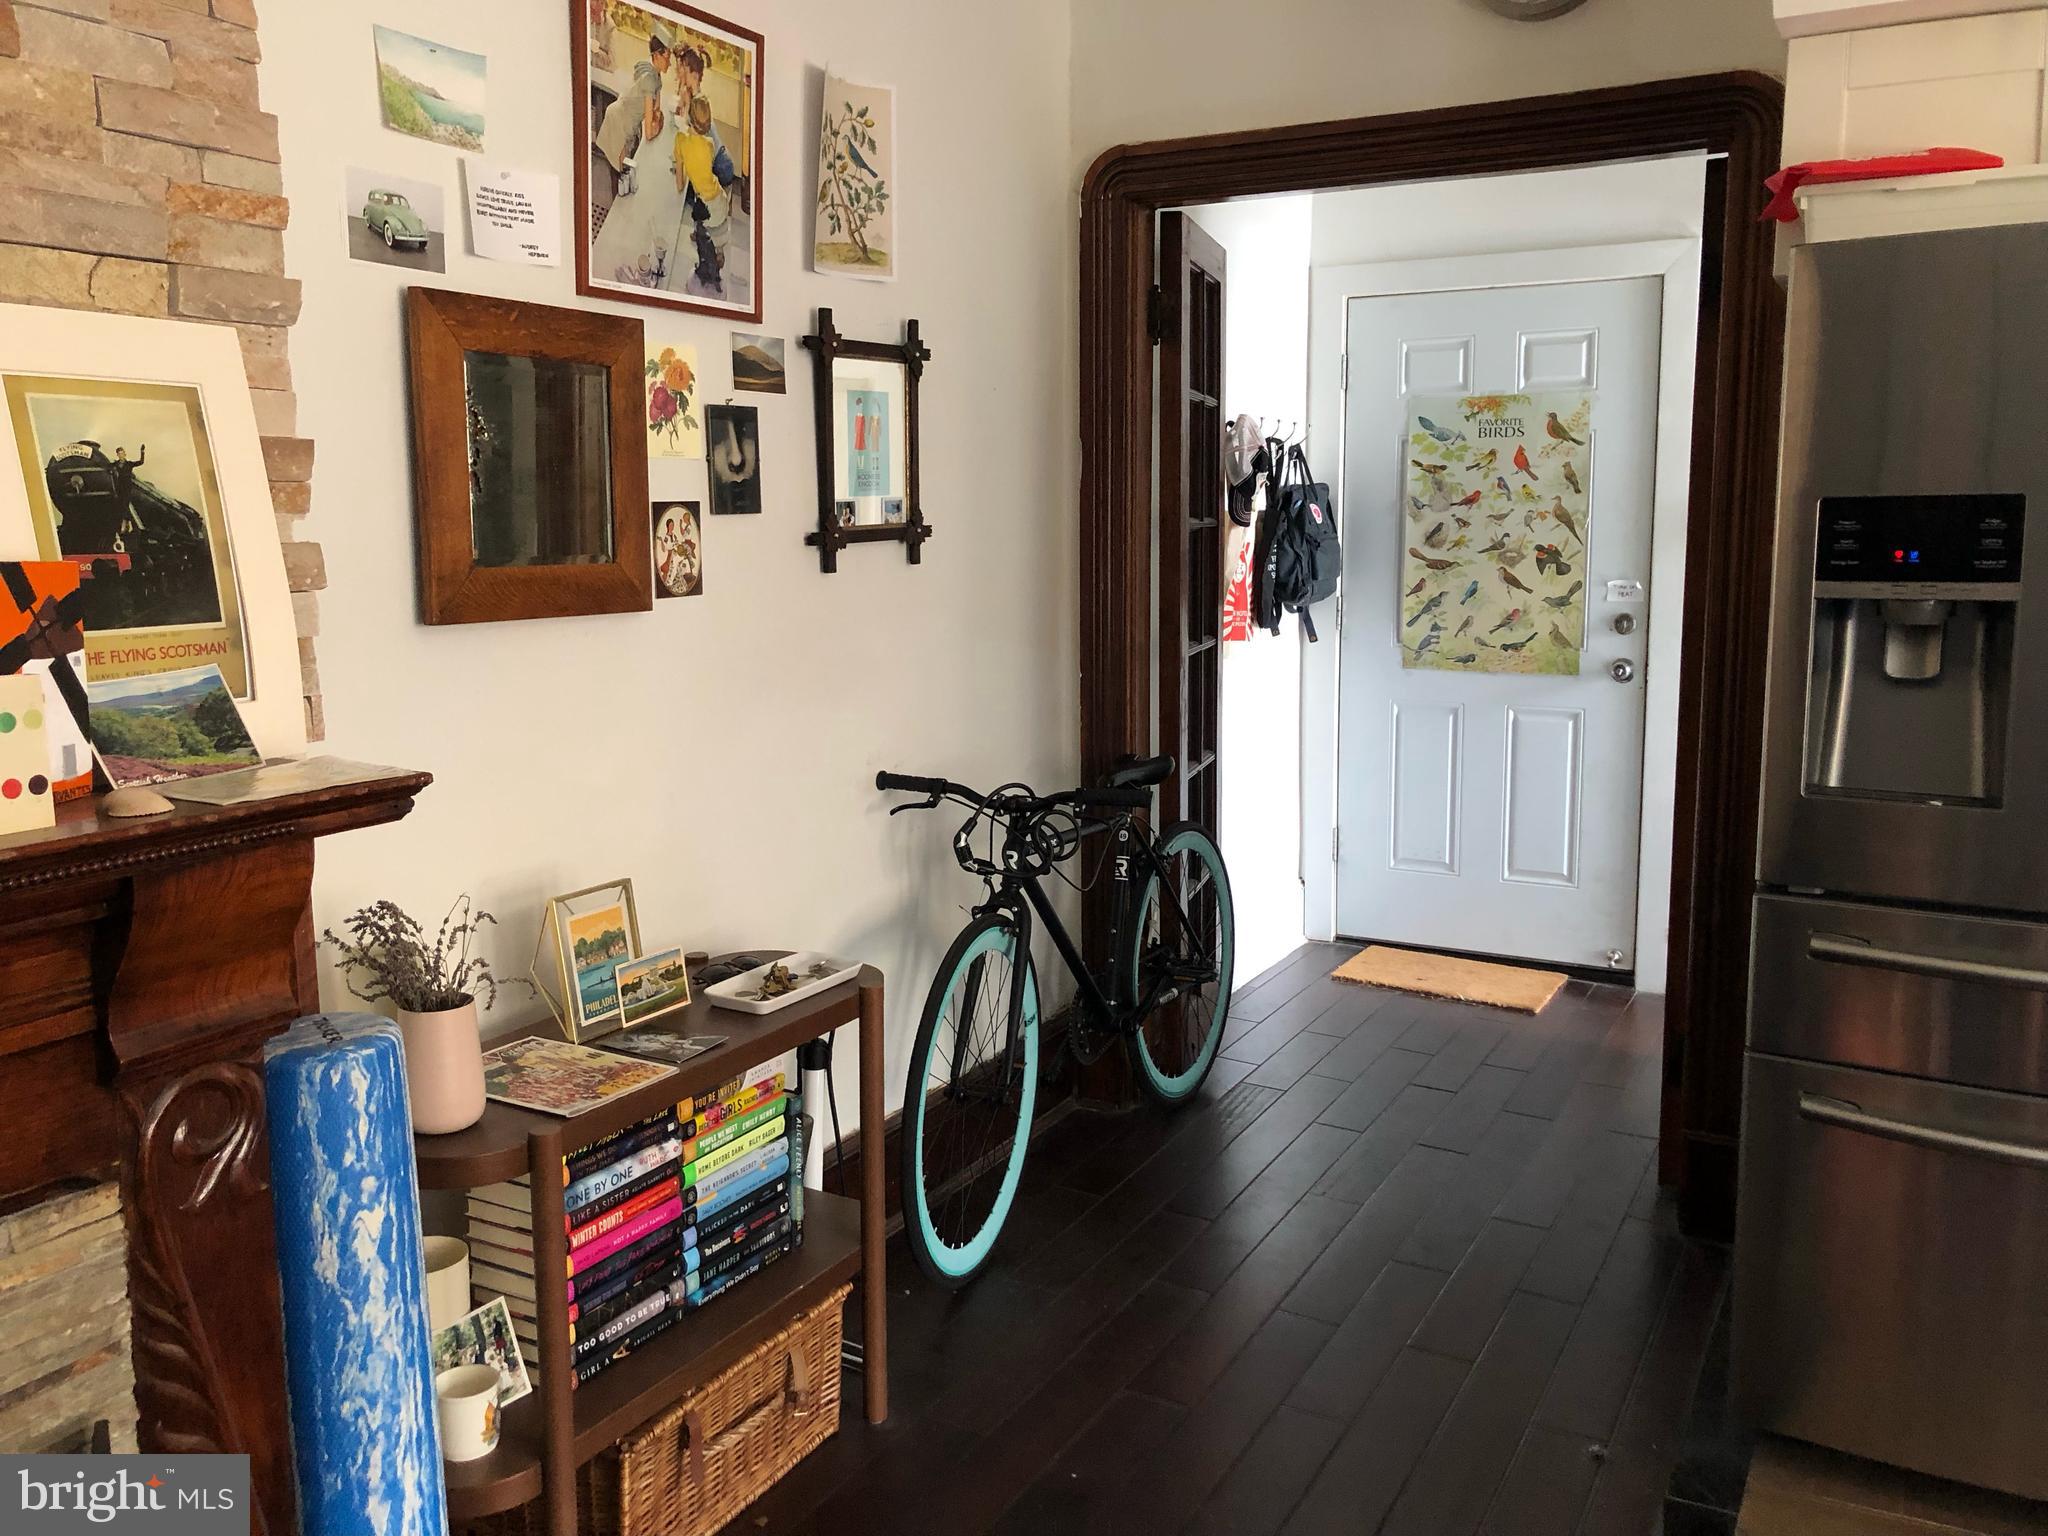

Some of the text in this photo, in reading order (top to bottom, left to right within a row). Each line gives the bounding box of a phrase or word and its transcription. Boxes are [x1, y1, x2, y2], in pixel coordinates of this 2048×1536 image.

[1478, 418, 1524, 426] FAVORITE
[1478, 426, 1525, 438] BIRDS
[110, 647, 156, 664] FLYING
[117, 772, 190, 788] Scottish Heather
[1006, 850, 1018, 870] R
[1115, 859, 1128, 876] R
[694, 1091, 716, 1110] YOU'RE
[720, 1098, 742, 1120] GIRLS
[758, 1106, 776, 1122] HENRY
[698, 1128, 776, 1175] HOME BEFORE DARK RILEY SAGER
[566, 1187, 590, 1209] ONE
[594, 1178, 608, 1196] BY
[610, 1166, 634, 1186] ONE
[702, 1184, 711, 1194] THE
[740, 1160, 758, 1175] SECRET
[572, 1210, 591, 1226] LIKE
[602, 1188, 630, 1208] SISTER
[705, 1216, 728, 1233] FLICKER
[740, 1200, 755, 1214] DARK
[572, 1210, 624, 1248] WINTER COUNTS
[612, 1236, 625, 1246] NOT
[704, 1268, 717, 1282] JANE
[718, 1252, 740, 1272] HARPER
[750, 1231, 776, 1252] SURVIVORS
[698, 1264, 760, 1306] Everything We Didn't Say
[578, 1293, 671, 1354] TOO GOOD TO BE TRUE
[580, 1358, 610, 1381] GIRL A
